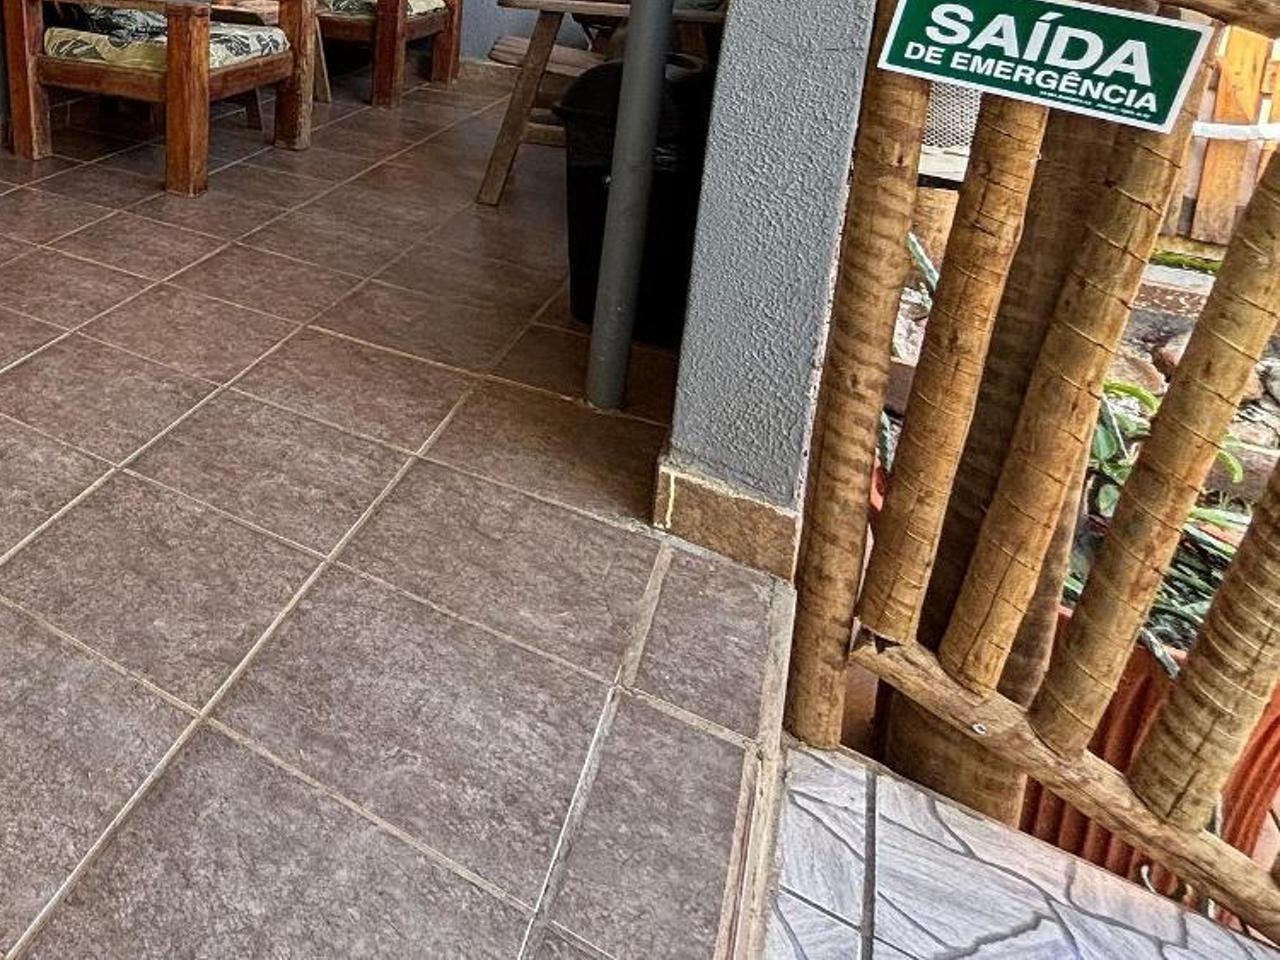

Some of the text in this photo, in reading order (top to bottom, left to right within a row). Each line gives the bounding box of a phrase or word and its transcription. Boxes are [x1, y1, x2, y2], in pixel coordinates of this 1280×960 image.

[905, 41, 944, 65] DE
[950, 51, 1157, 113] EMERGÊNCIA
[925, 3, 1152, 87] SAÍDA
